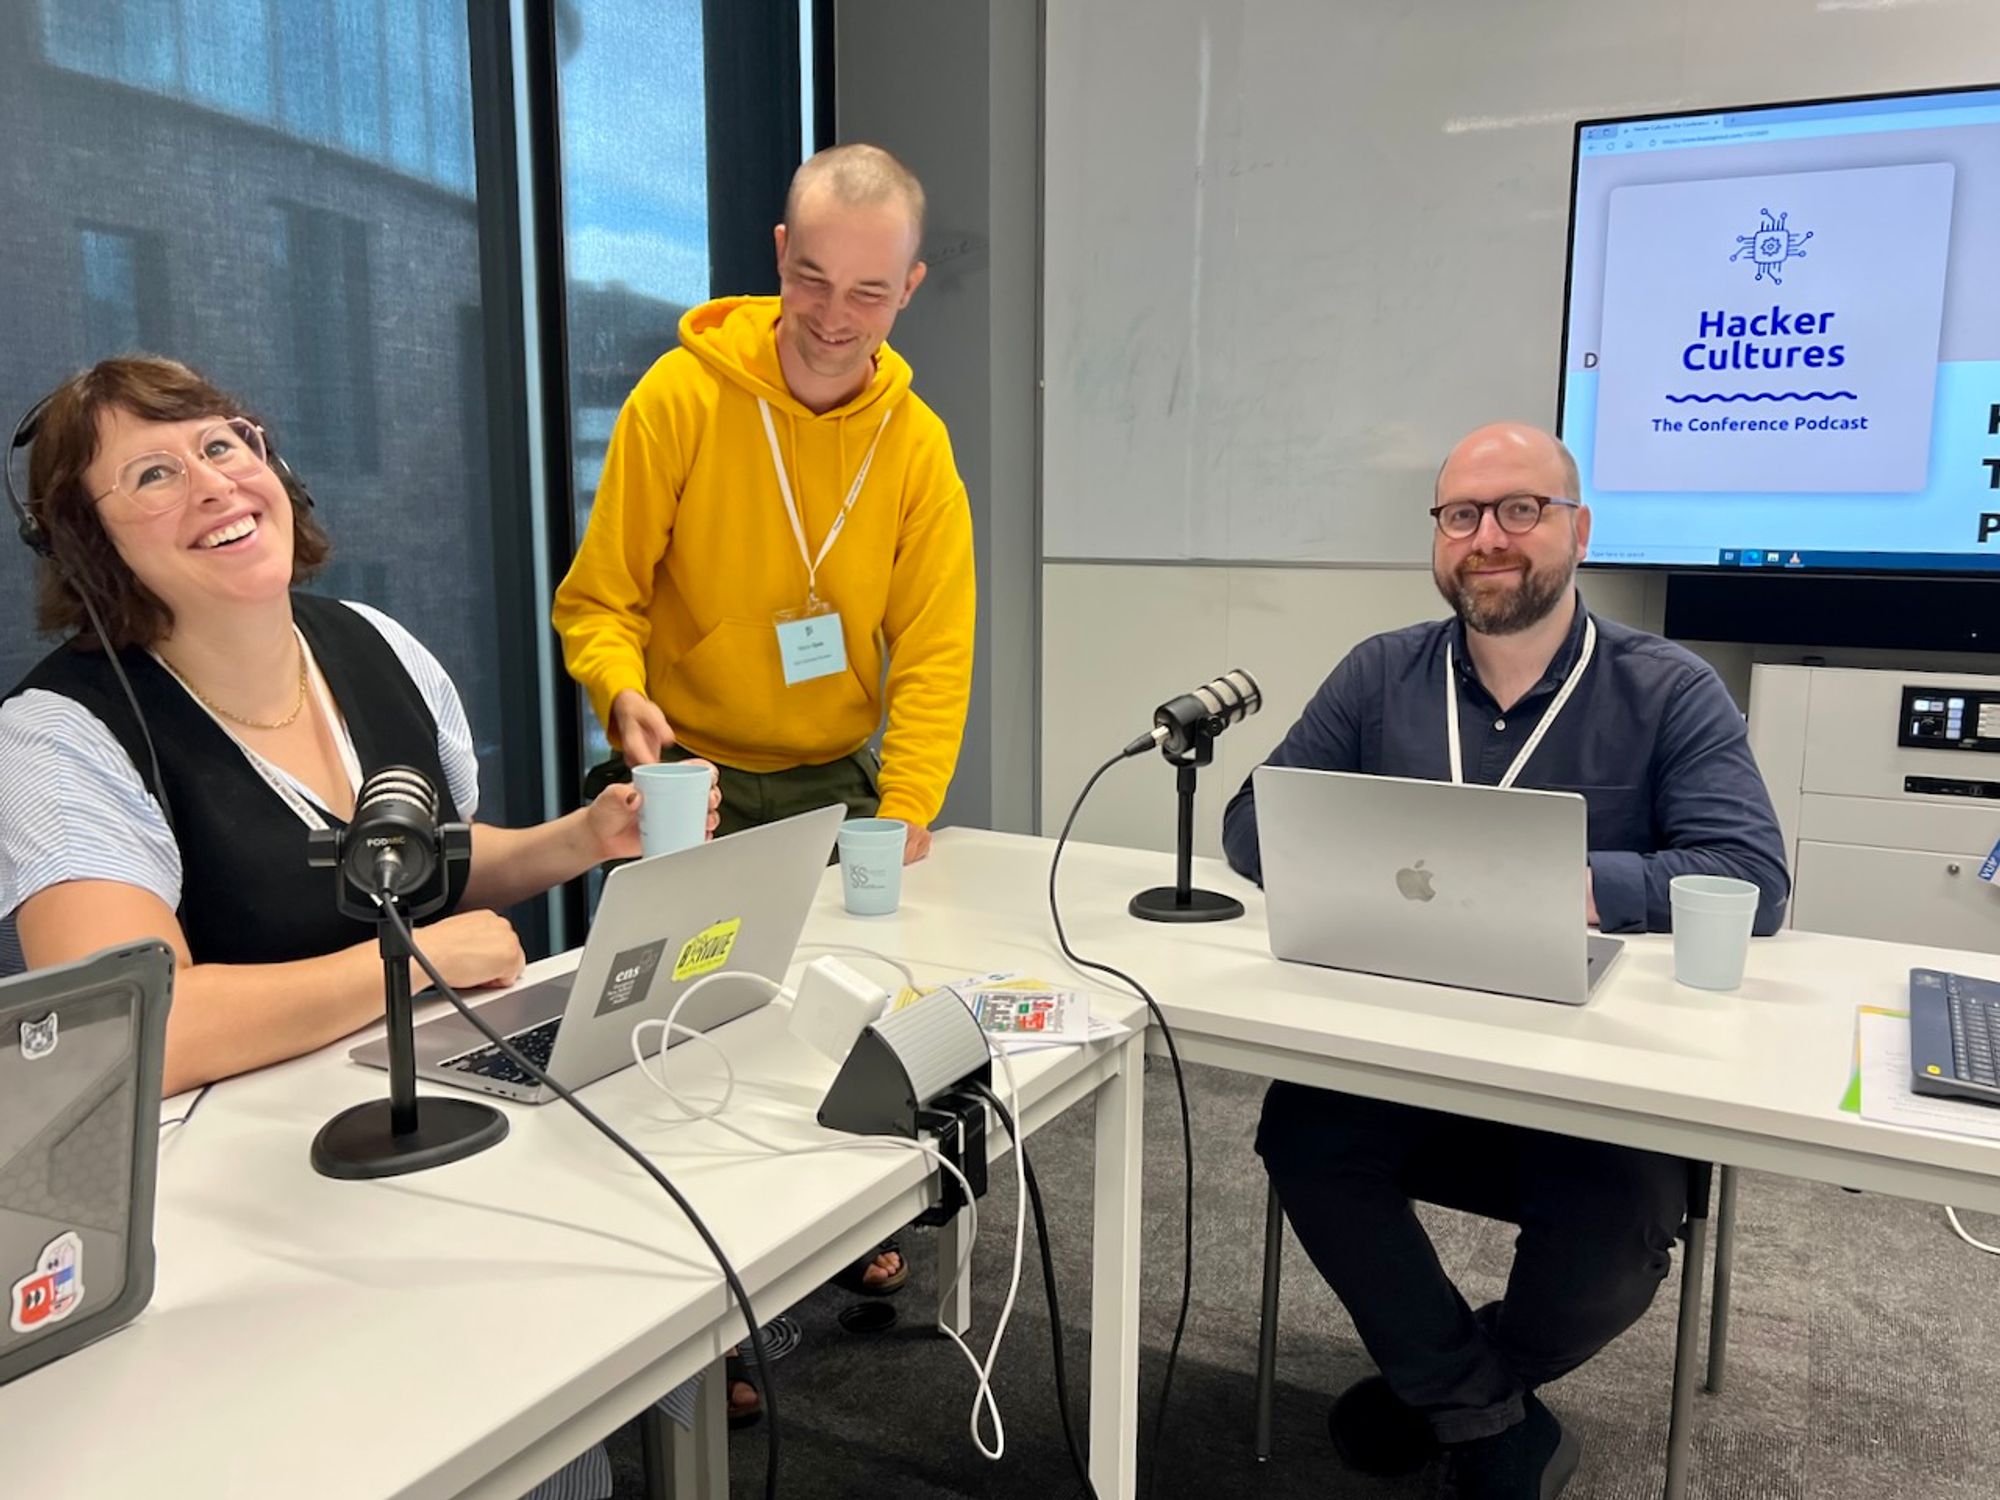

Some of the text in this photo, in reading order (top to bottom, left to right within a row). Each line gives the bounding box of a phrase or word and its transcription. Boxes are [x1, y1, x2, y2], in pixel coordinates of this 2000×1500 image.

[1699, 305, 1835, 338] Hacker
[1682, 339, 1845, 371] Cultures
[1651, 416, 1868, 432] The Conference Podcast
